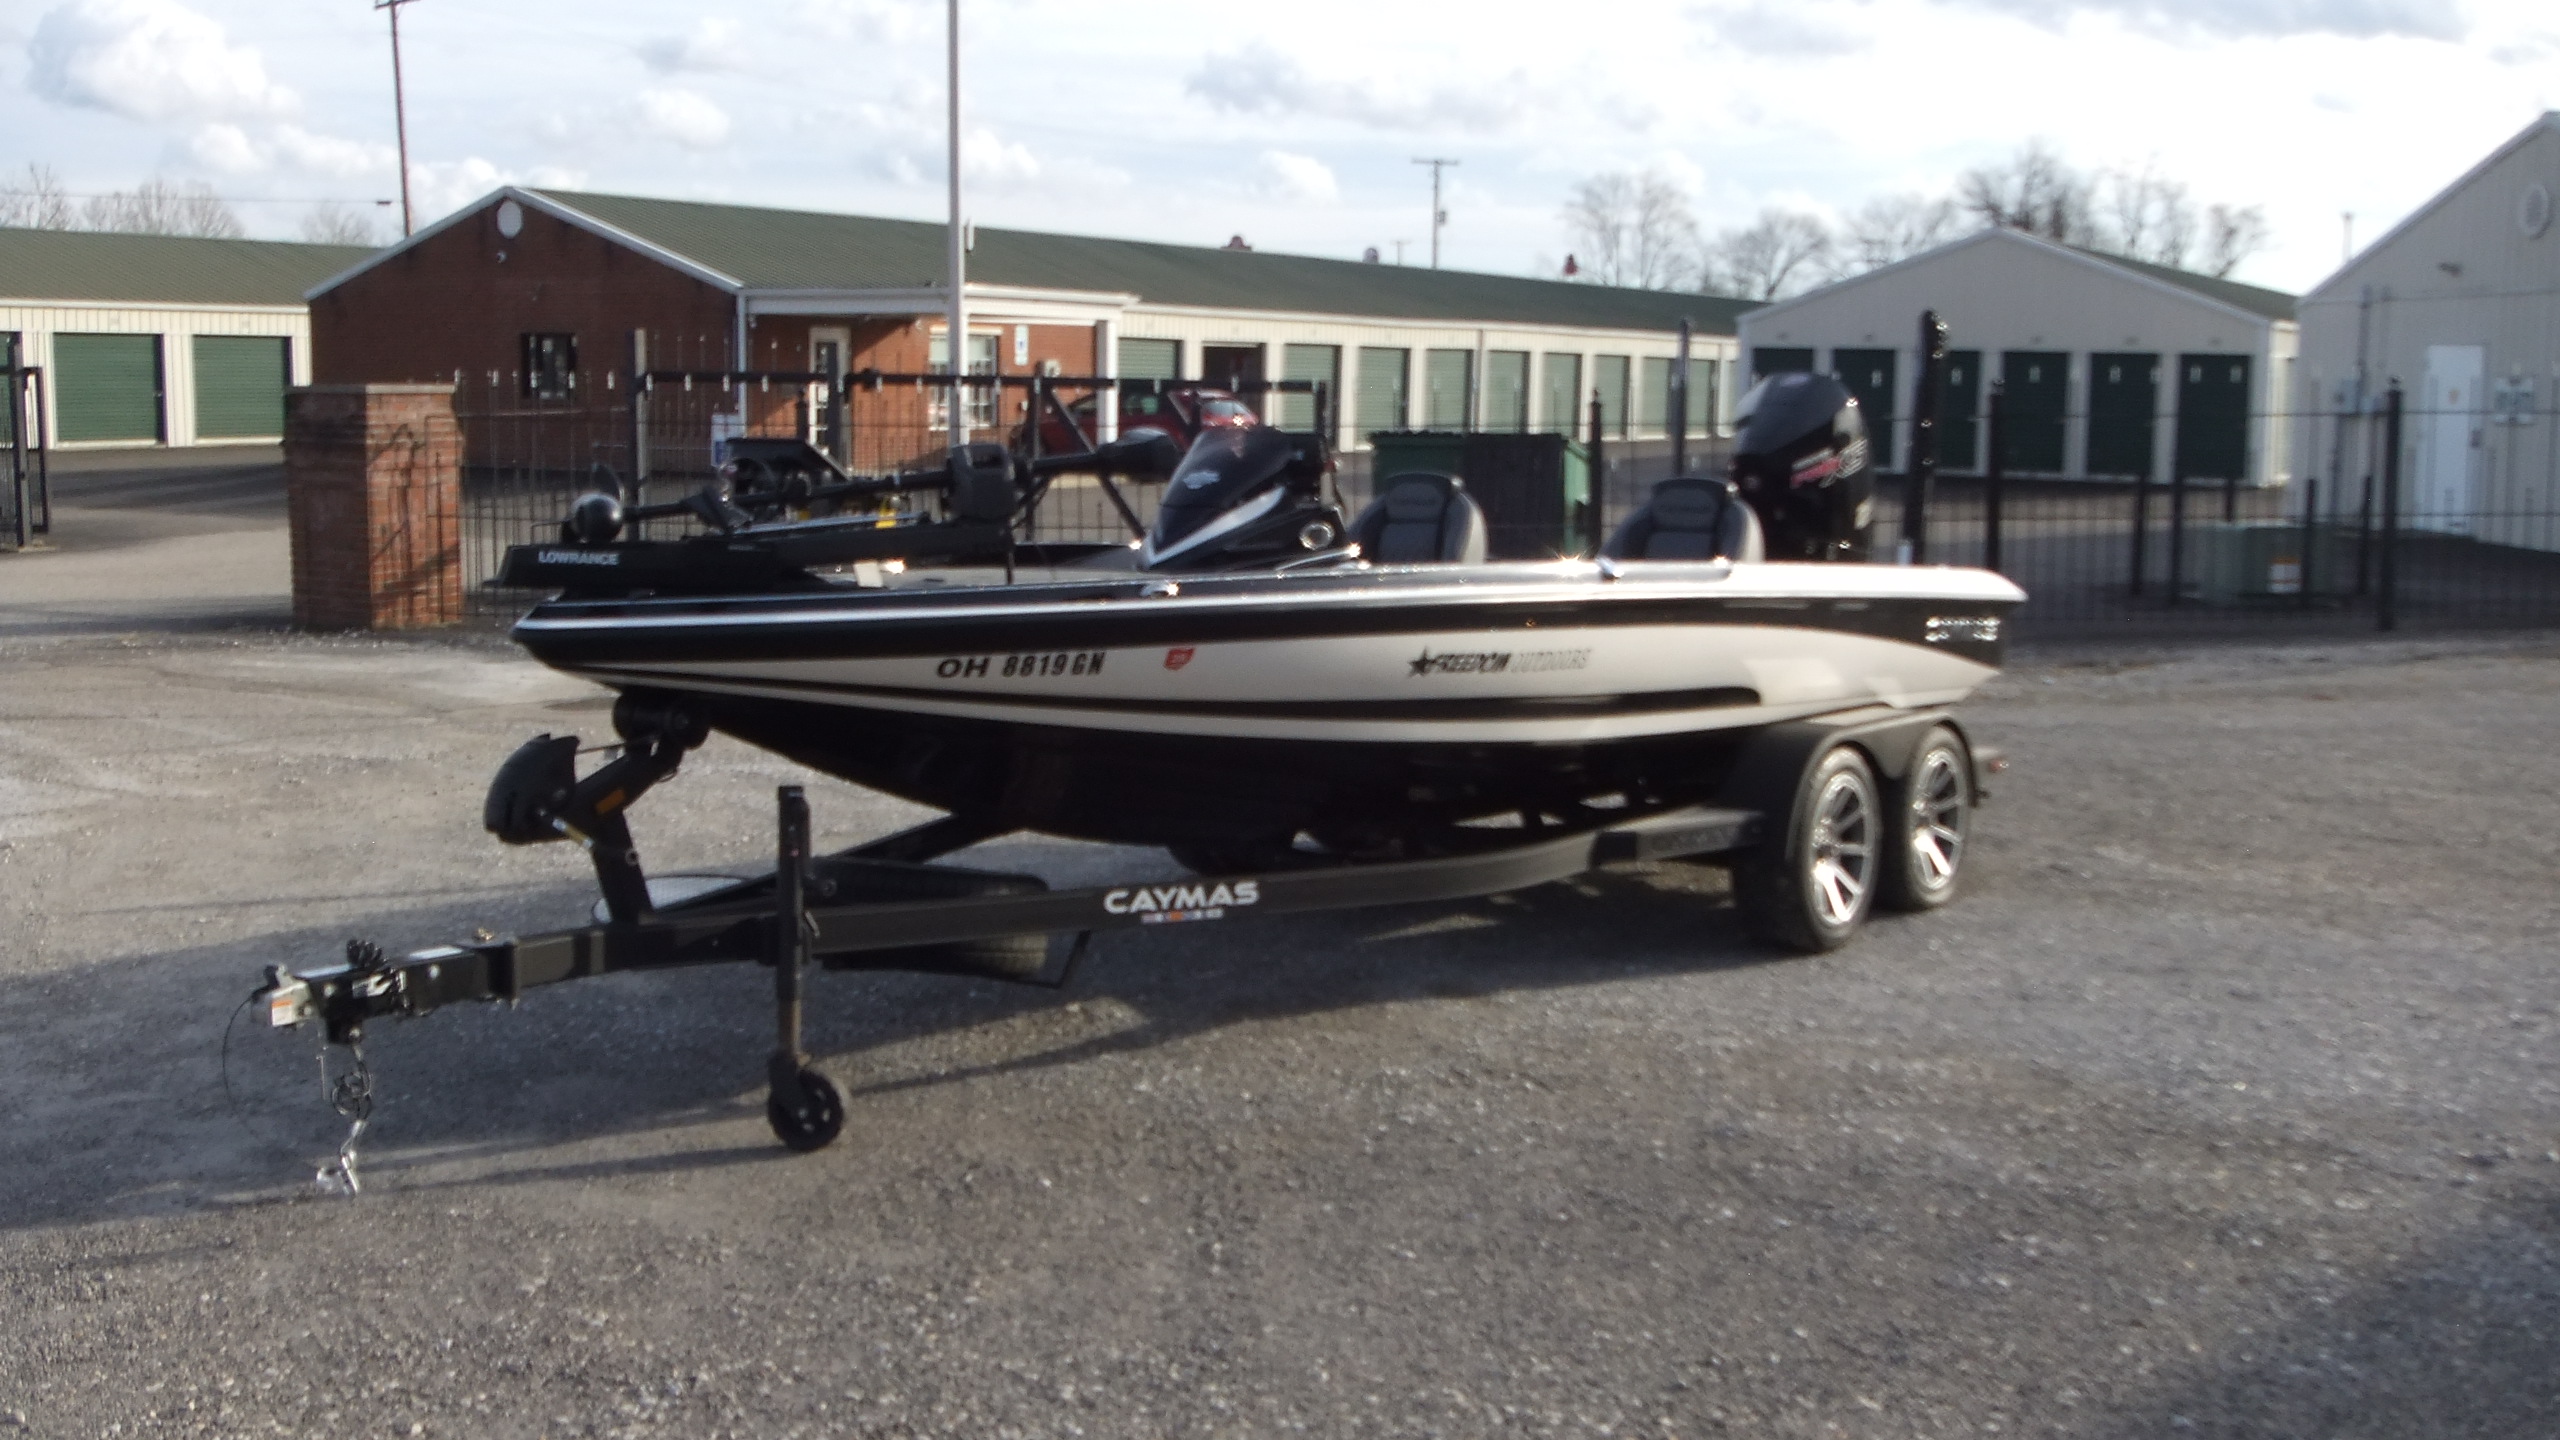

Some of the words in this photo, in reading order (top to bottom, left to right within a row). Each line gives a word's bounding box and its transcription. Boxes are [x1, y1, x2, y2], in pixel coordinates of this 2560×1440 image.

[537, 551, 619, 565] LOWRANCE
[936, 656, 991, 678] OH
[1103, 880, 1260, 914] CAYMAS
